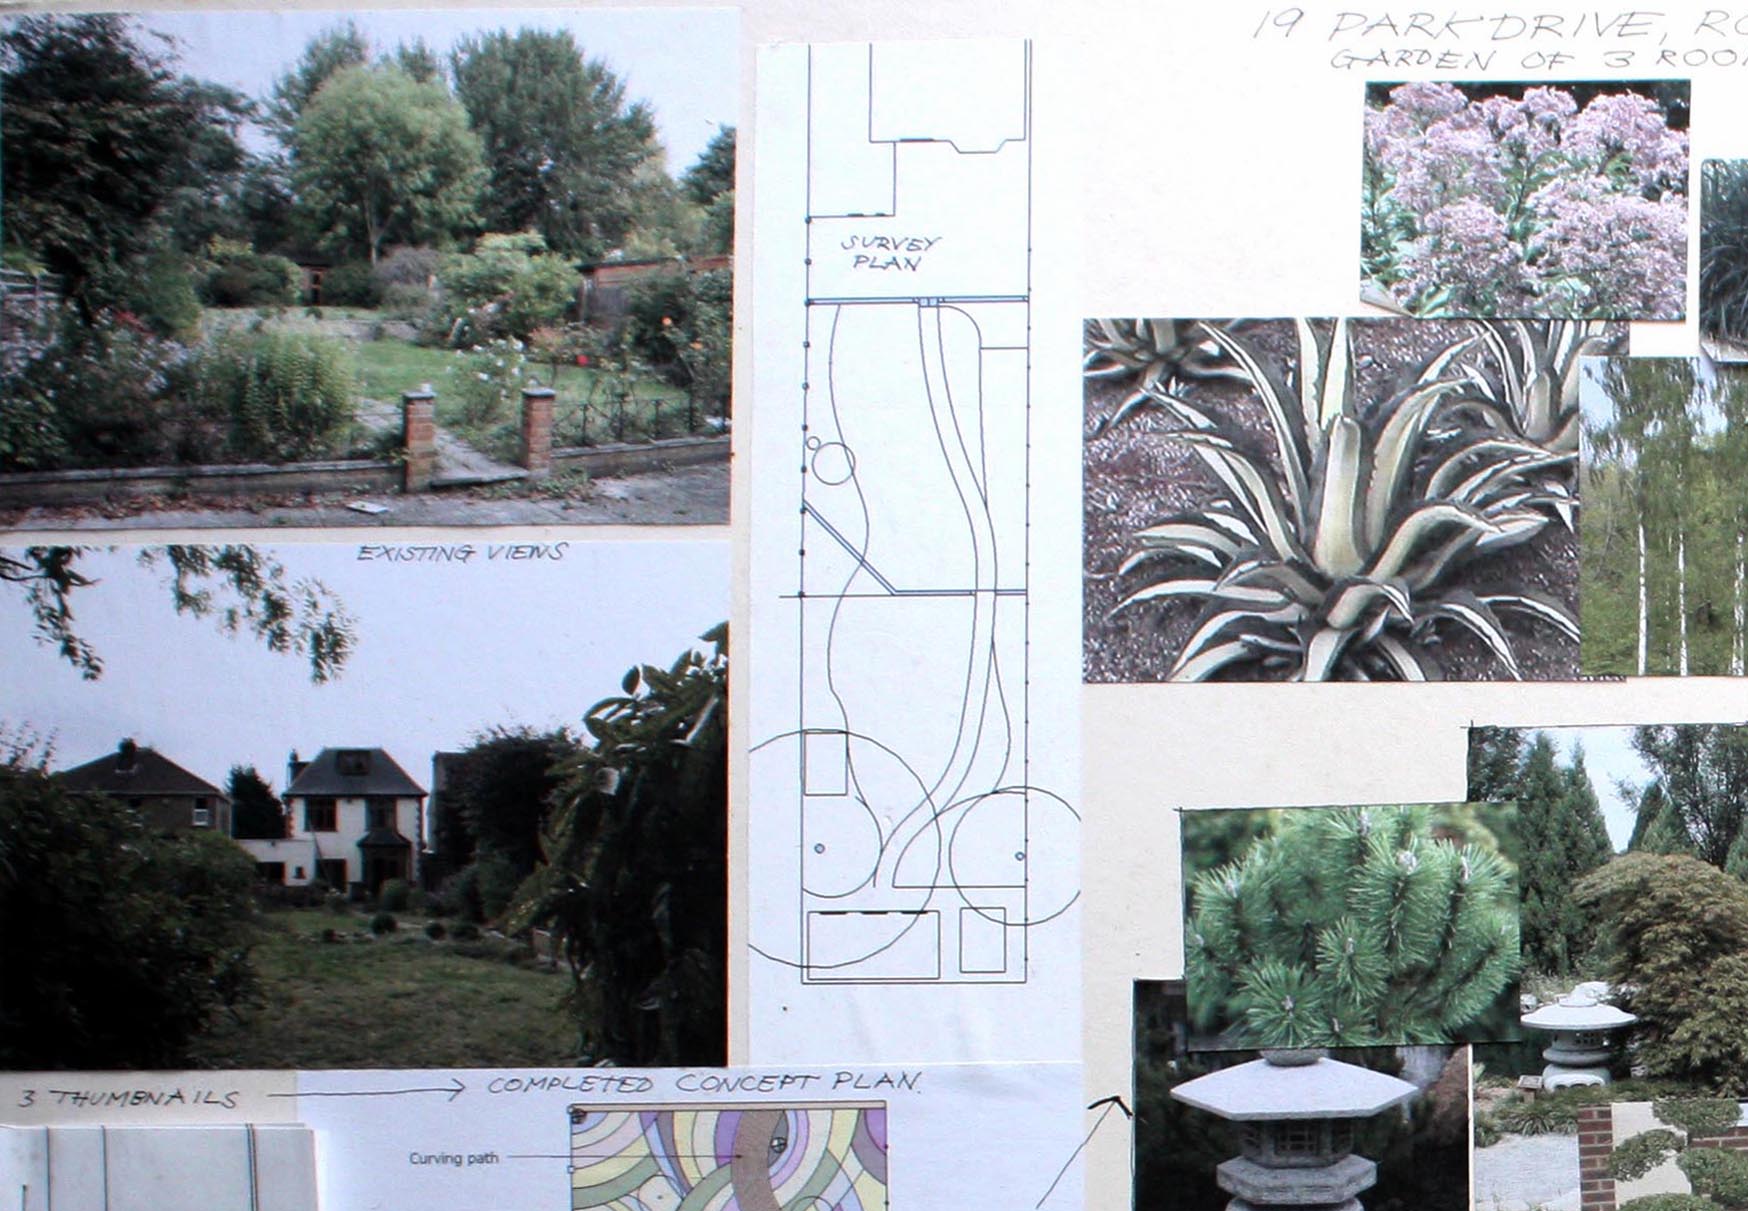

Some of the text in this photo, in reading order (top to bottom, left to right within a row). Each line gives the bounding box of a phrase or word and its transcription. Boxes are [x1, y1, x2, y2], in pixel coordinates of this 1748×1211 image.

[1253, 8, 1305, 39] 19
[1330, 48, 1498, 71] GARDEN
[1520, 51, 1576, 71] OF
[1604, 51, 1635, 68] 3
[840, 235, 943, 252] SURVEY
[852, 254, 923, 272] PLAN
[356, 541, 570, 564] EXISTING VIEWS
[487, 1074, 654, 1095] COMPLETED
[675, 1072, 823, 1093] CONCEPT
[17, 1088, 241, 1110] 3 THUMBNAILS
[409, 1152, 499, 1167] Curving path
